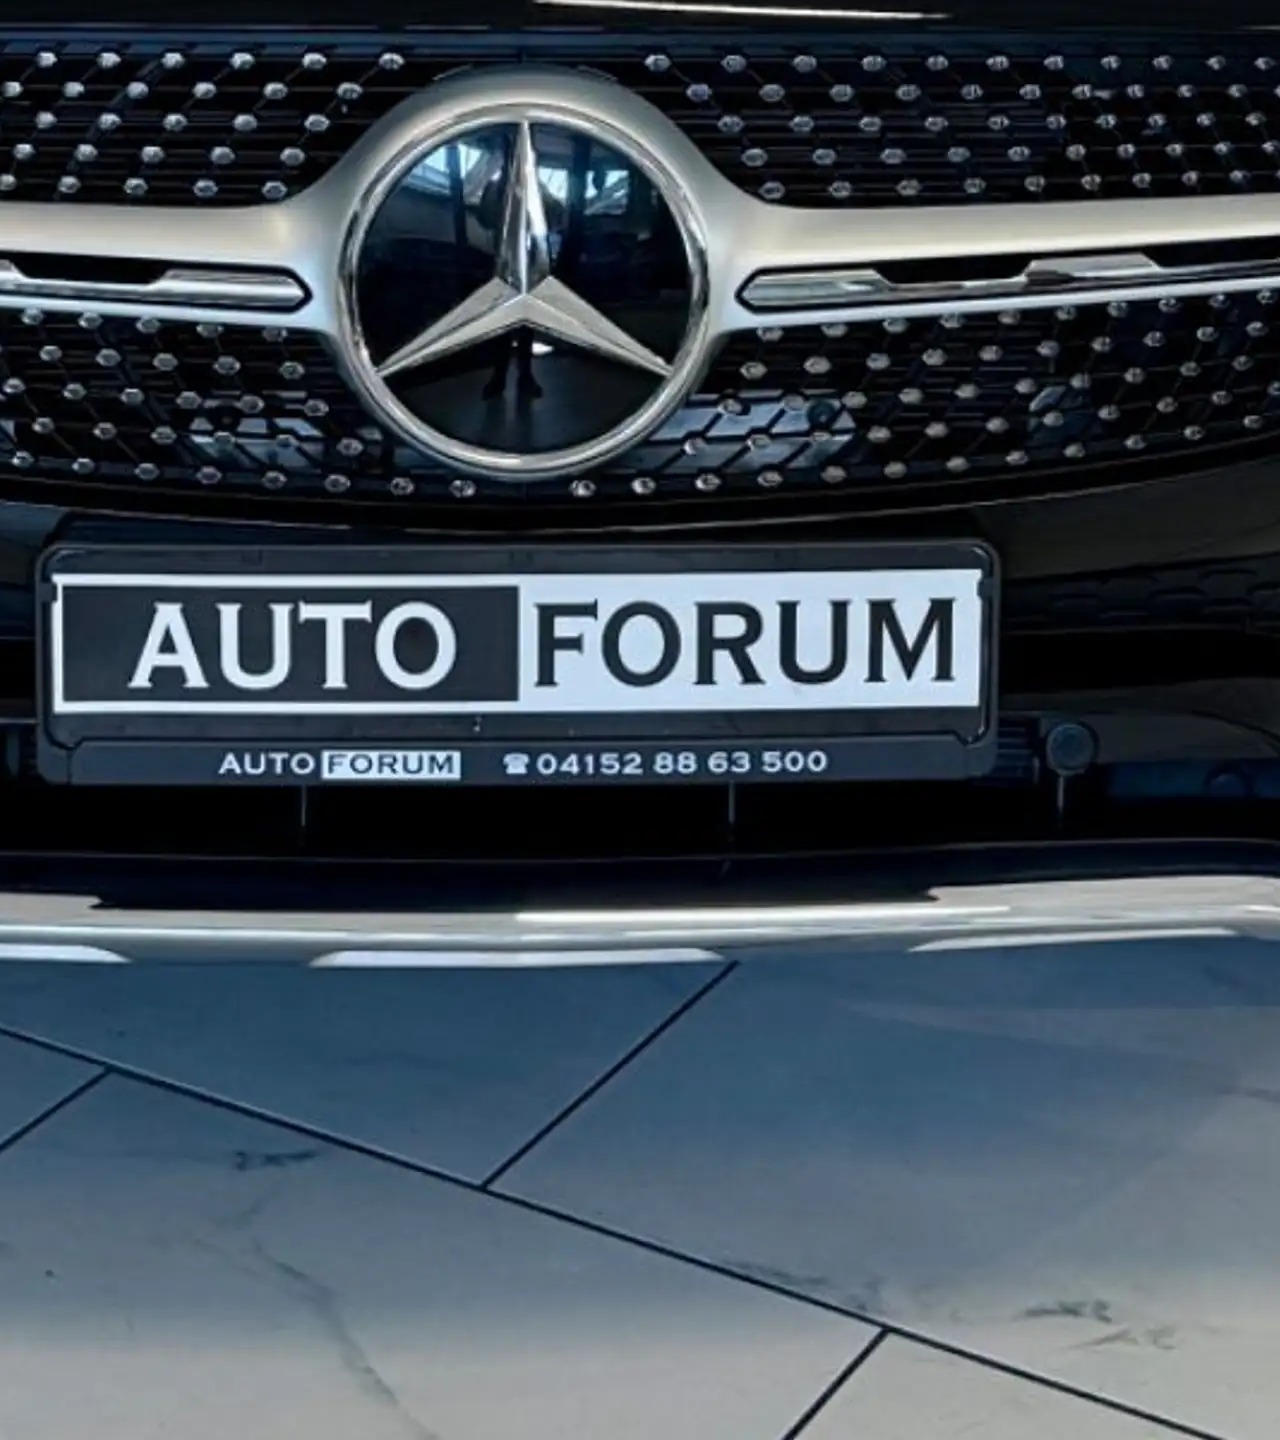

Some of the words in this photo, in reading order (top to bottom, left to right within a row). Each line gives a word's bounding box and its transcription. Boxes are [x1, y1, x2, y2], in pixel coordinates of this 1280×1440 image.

[127, 600, 457, 689] AUTO
[534, 597, 956, 687] FORUM
[218, 751, 316, 775] AUTO
[326, 753, 456, 775] FORUM
[536, 753, 643, 775] 04152
[653, 752, 697, 774] 88
[707, 751, 751, 773] 63
[761, 750, 827, 772] 500
